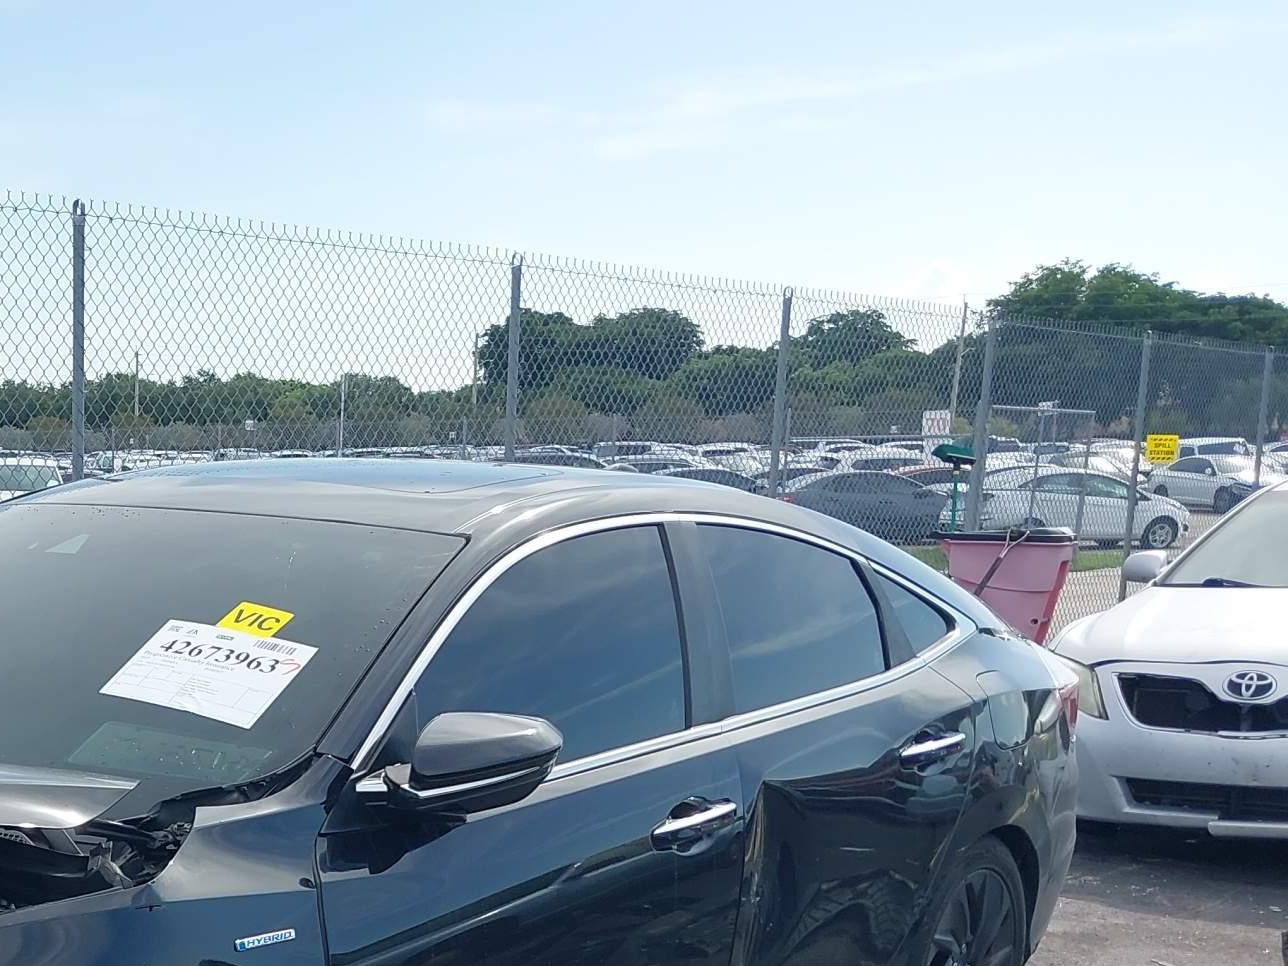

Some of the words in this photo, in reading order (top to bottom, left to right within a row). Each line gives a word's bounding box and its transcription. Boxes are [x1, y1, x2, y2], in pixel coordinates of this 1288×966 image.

[233, 609, 281, 631] VIC
[159, 639, 280, 674] 42673963
[247, 931, 293, 947] HYBRID
